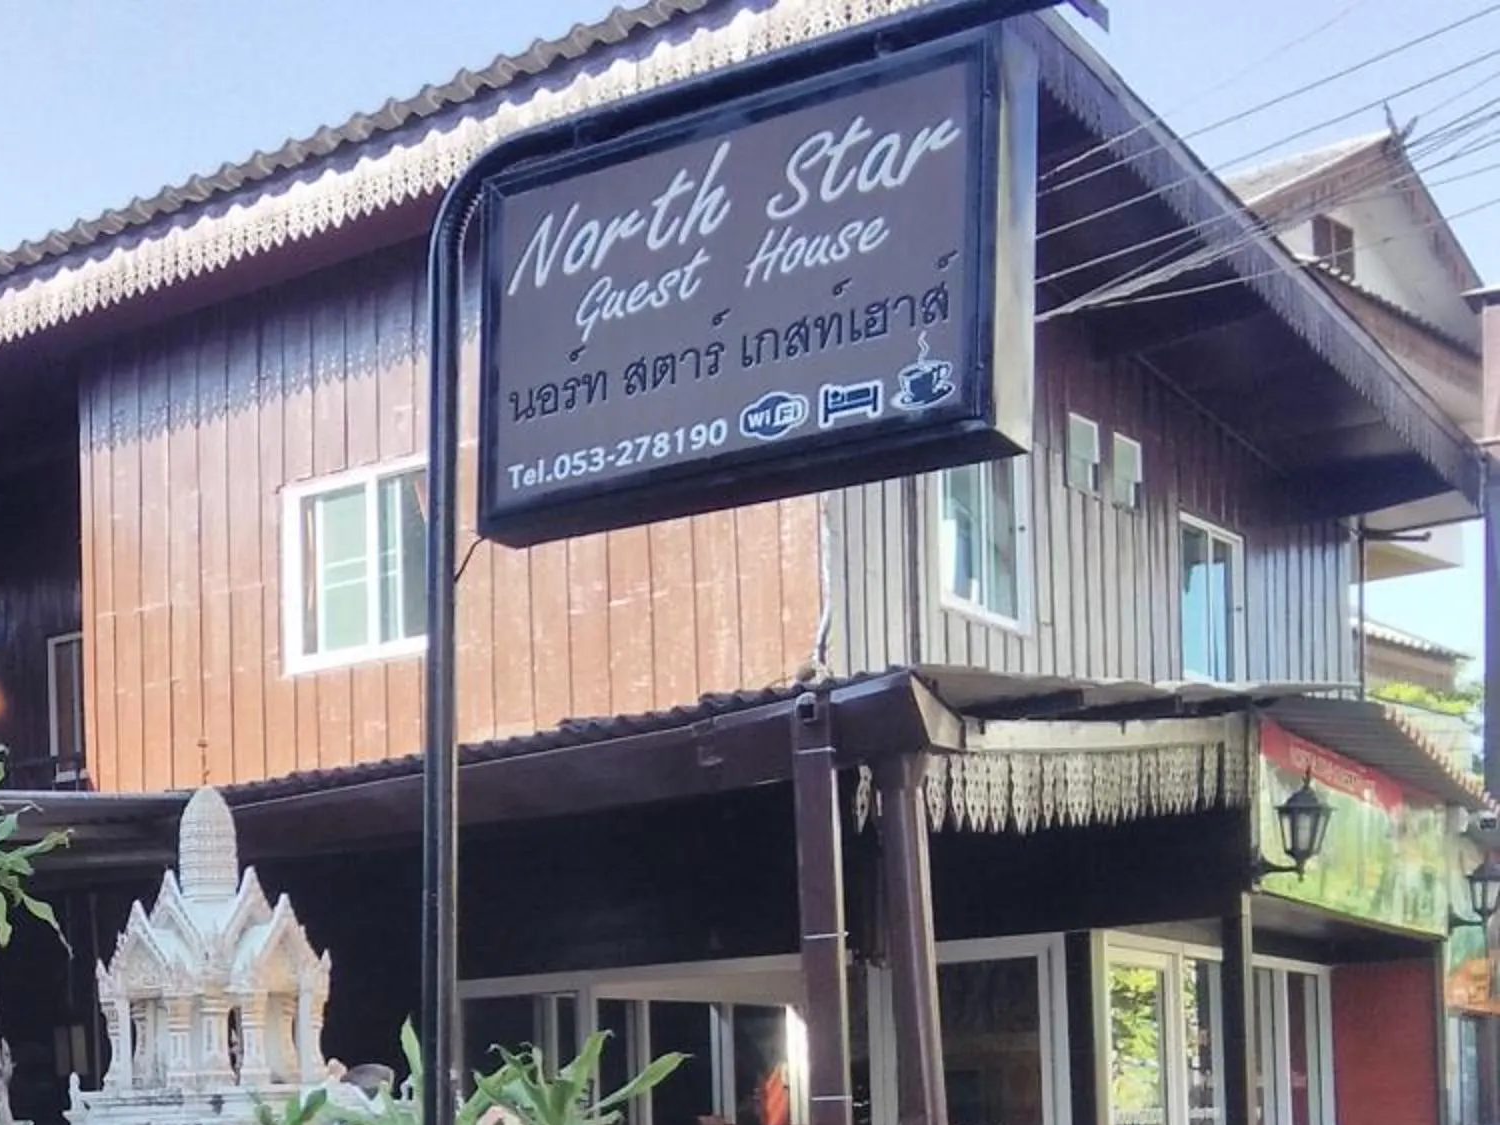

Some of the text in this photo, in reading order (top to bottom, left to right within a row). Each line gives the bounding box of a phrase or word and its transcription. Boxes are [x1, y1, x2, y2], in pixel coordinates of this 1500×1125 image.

[507, 116, 960, 296] North Star
[576, 216, 890, 342] Guest House
[509, 251, 958, 421] นอร์ท สตาร์ เกสท์เฮาส์
[509, 420, 728, 488] Tel.053-278190
